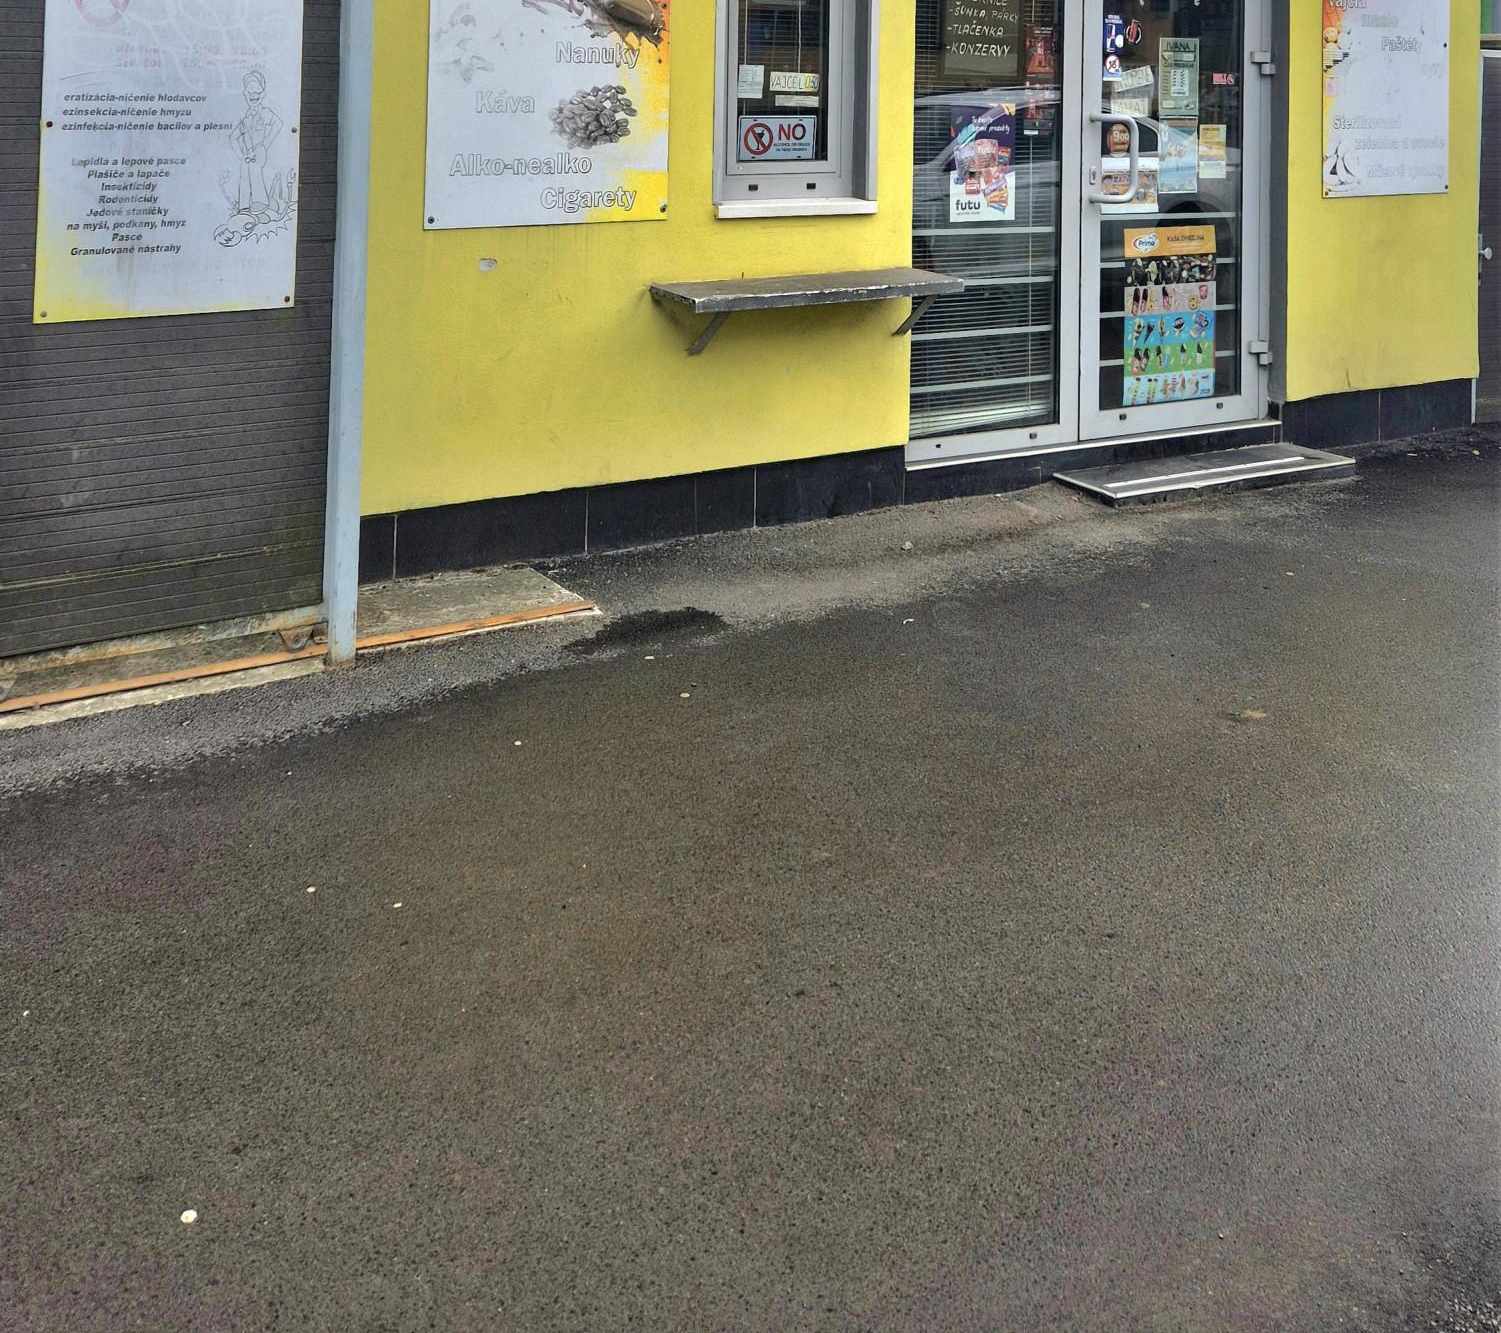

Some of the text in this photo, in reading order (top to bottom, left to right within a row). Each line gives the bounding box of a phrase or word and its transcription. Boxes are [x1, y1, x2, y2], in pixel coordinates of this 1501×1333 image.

[556, 41, 640, 69] Nanuky
[157, 92, 207, 103] hlodavcov
[475, 89, 535, 114] Káva
[160, 107, 192, 118] hmyzu
[777, 123, 807, 141] NO
[111, 158, 118, 166] a
[449, 153, 593, 177] Alko-nealko
[540, 186, 637, 214] Cigarety
[955, 199, 981, 211] futu
[66, 222, 80, 231] na
[160, 218, 187, 229] hmyz
[111, 233, 143, 242] Pasce
[70, 244, 182, 256] Granulované nástrahy
